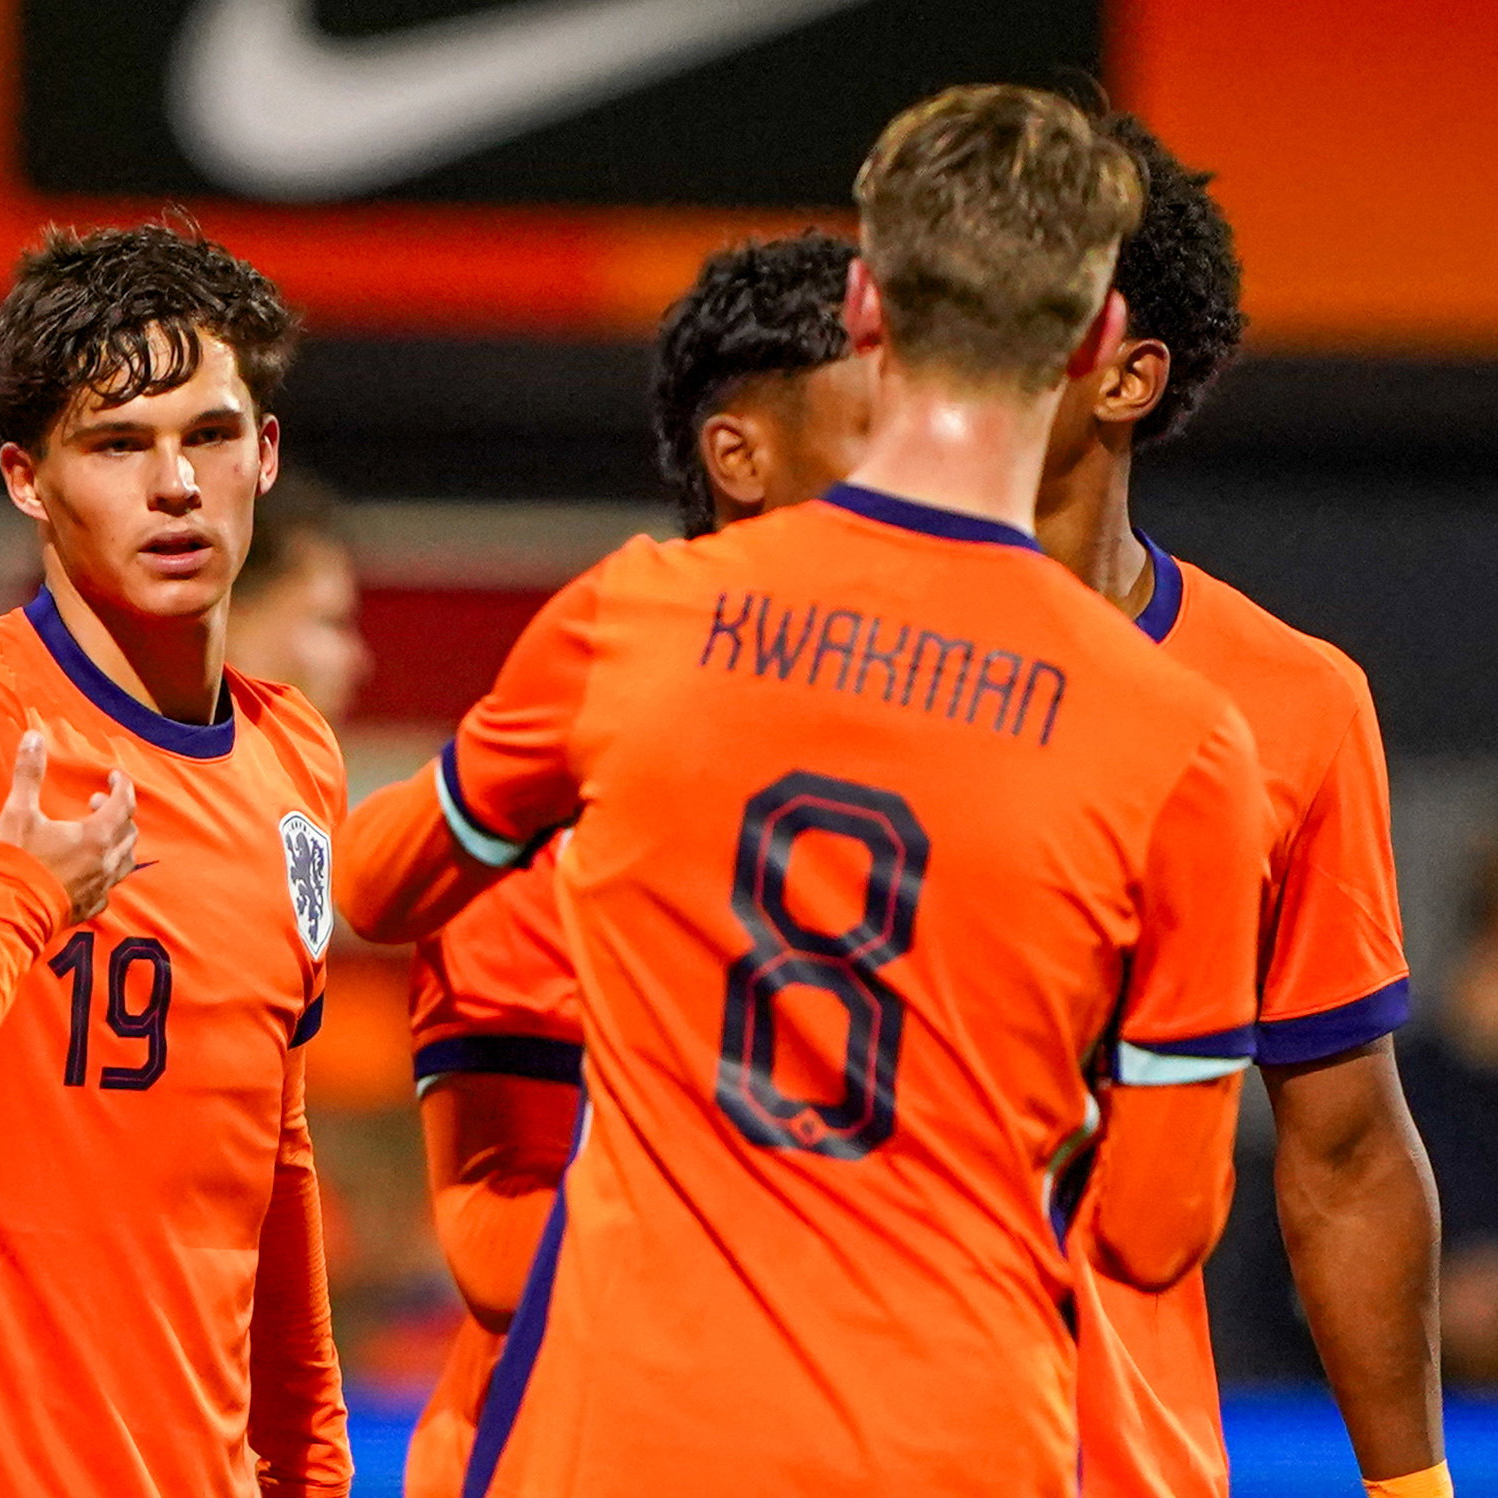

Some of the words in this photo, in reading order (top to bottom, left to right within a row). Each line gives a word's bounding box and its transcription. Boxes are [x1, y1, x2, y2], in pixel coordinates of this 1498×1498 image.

[700, 593, 1068, 747] KWAKMAN
[48, 931, 172, 1091] 19
[714, 769, 931, 1161] 8
